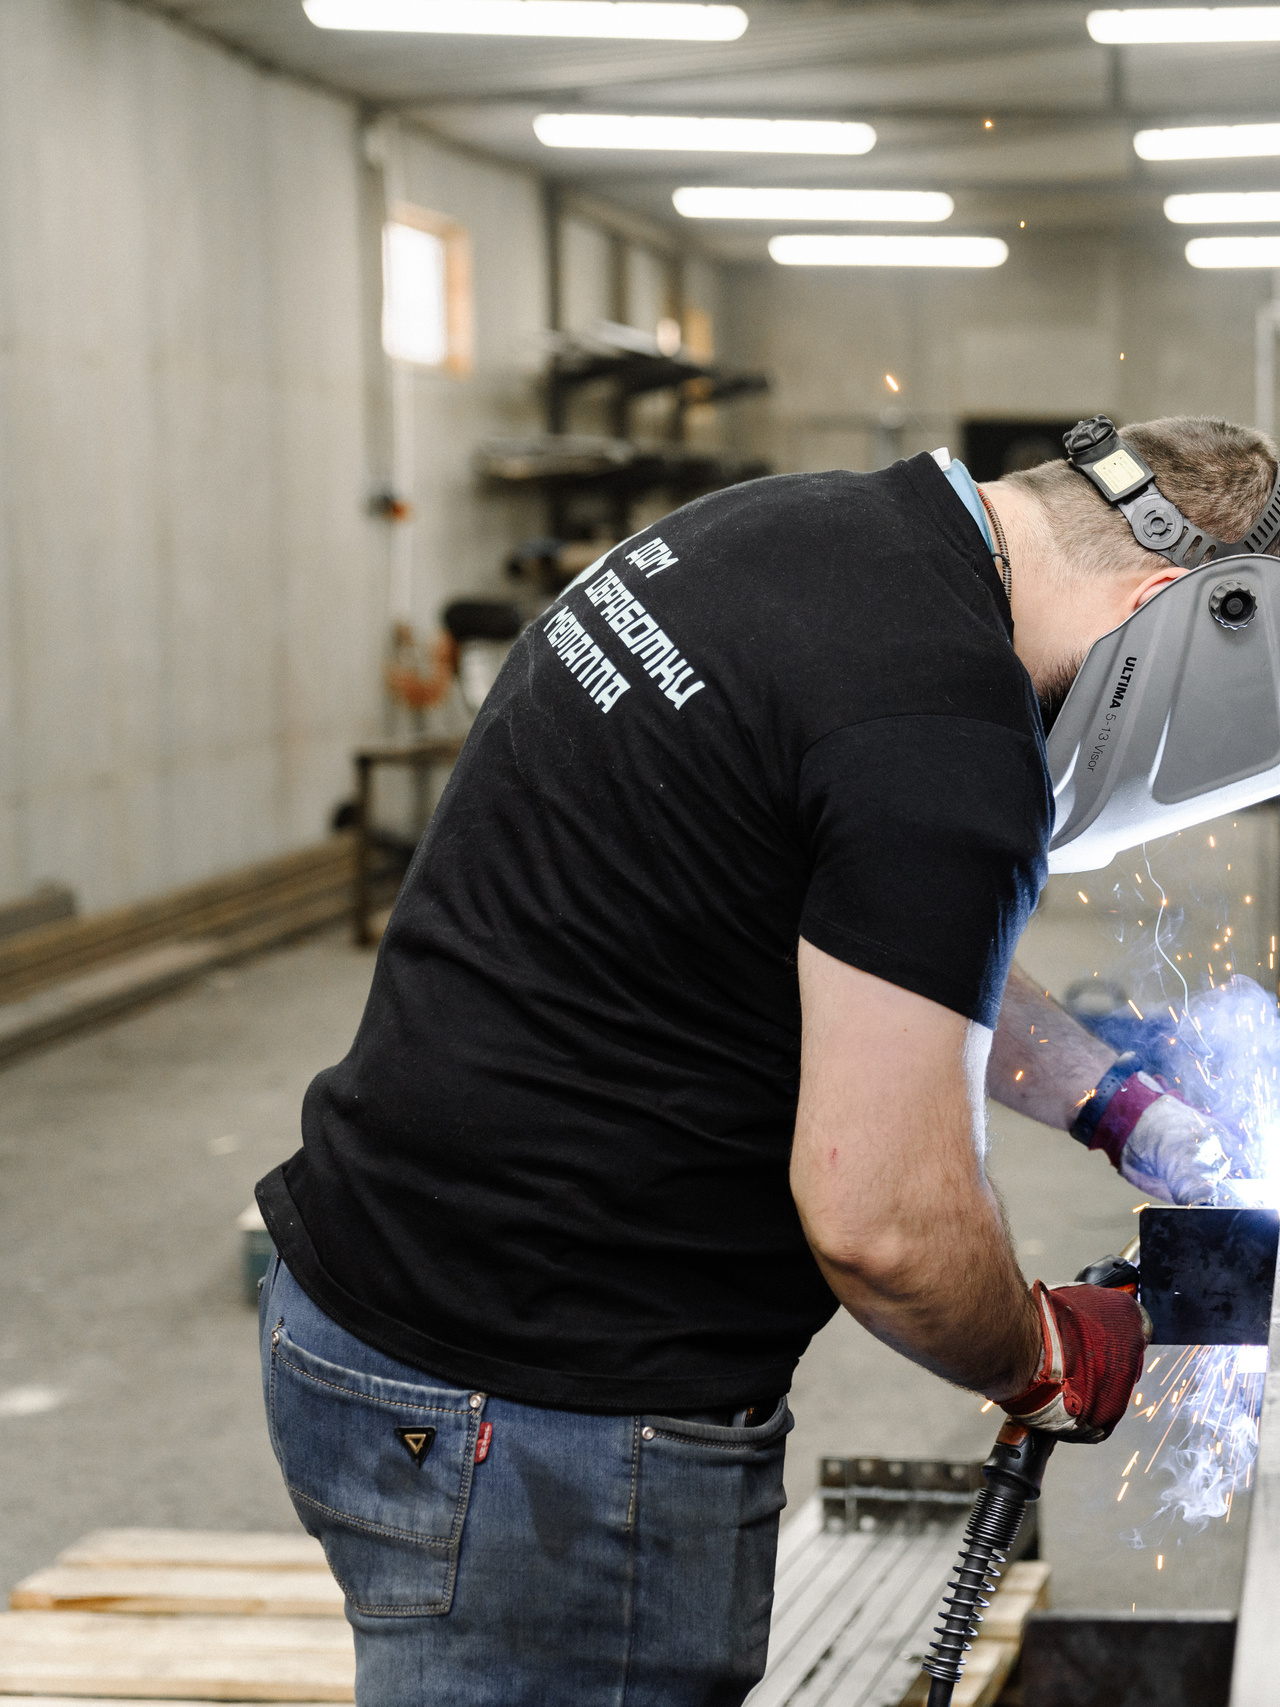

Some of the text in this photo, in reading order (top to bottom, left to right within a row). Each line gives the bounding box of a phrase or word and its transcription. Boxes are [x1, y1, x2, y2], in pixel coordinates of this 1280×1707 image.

[625, 537, 679, 578] ДОМ
[1087, 656, 1137, 772] ULTIMA 5-13 Visor
